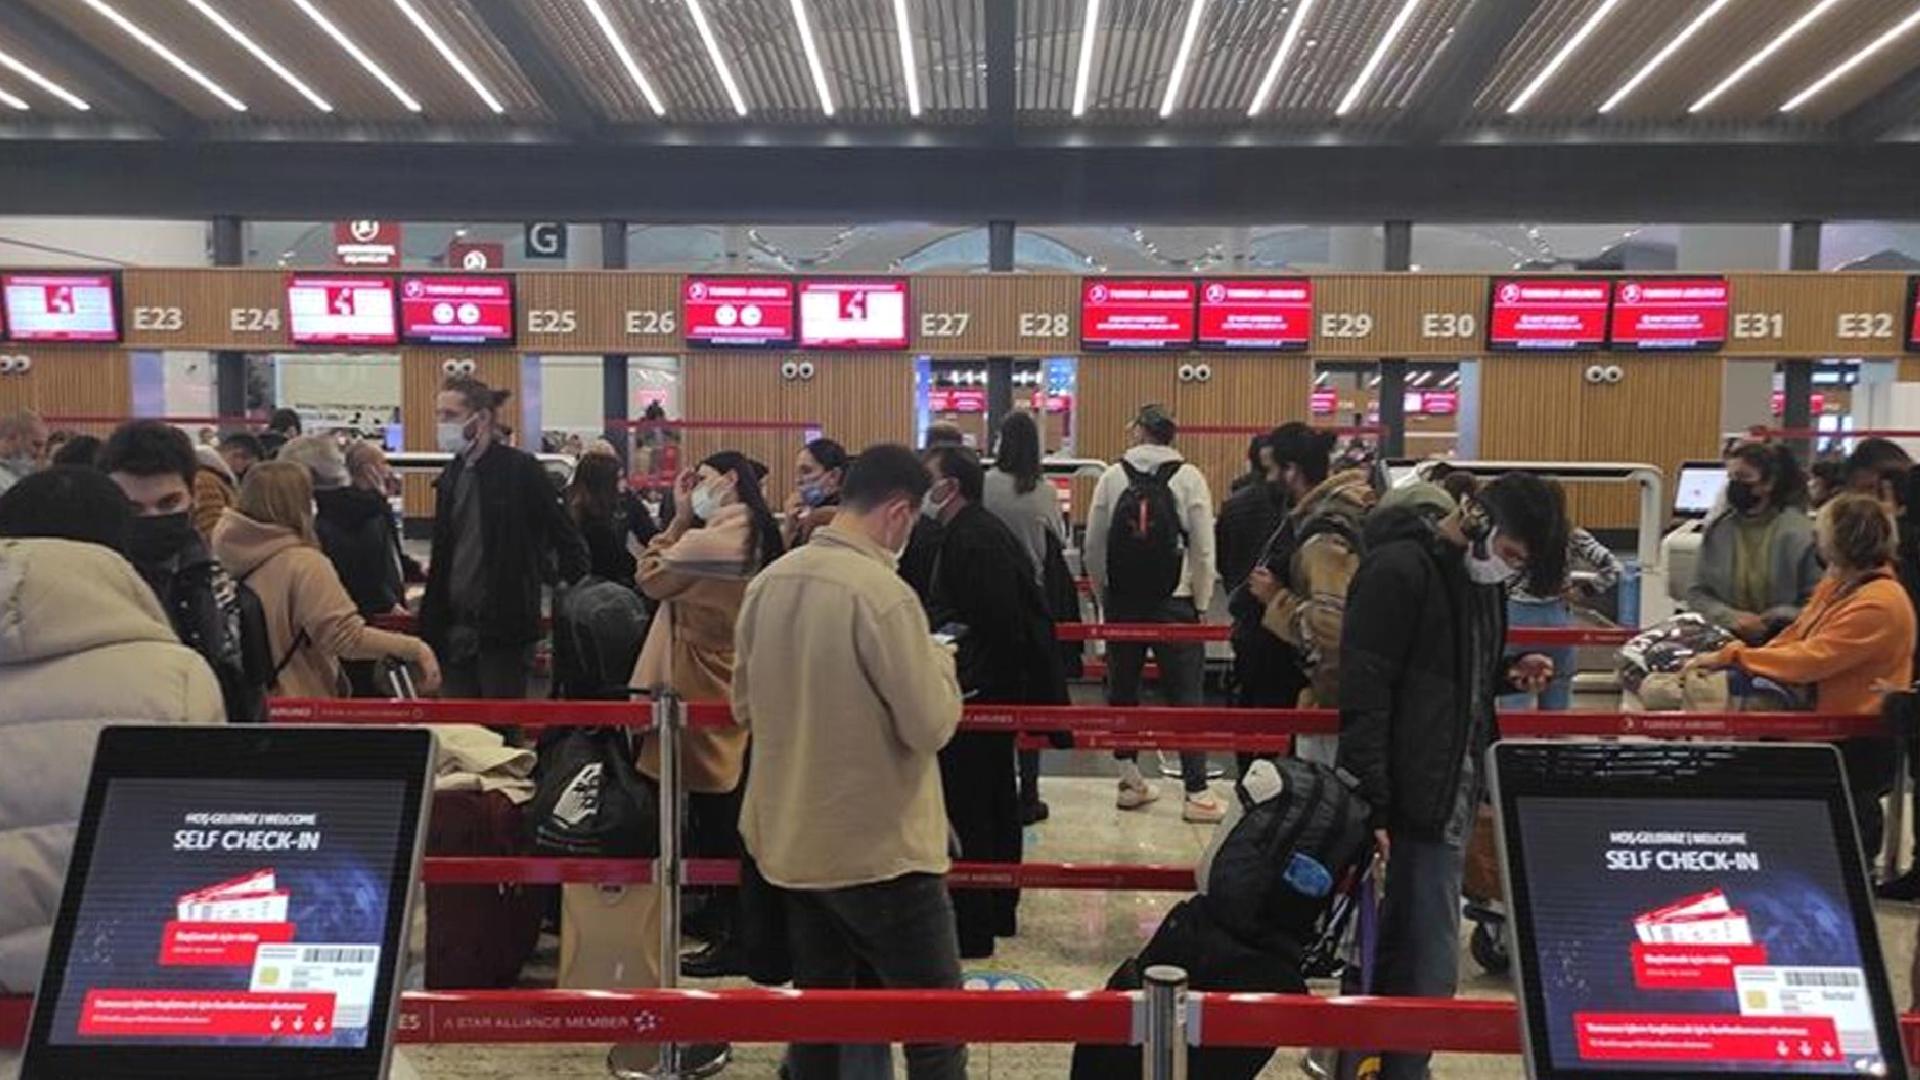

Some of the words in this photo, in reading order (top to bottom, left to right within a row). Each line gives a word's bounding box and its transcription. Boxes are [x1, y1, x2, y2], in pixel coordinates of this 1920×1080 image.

[530, 222, 557, 253] G
[134, 309, 183, 332] E23
[230, 309, 279, 332] E24
[528, 310, 576, 332] E25
[626, 311, 676, 333] E26
[921, 313, 969, 336] E27
[1019, 313, 1069, 336] E28
[1321, 314, 1372, 337] E29
[1422, 314, 1476, 338] E30
[1734, 314, 1783, 338] E31
[1838, 314, 1892, 338] E32
[173, 830, 220, 851] SELF
[221, 830, 320, 851] CHECK-IN
[1605, 850, 1652, 871] SELF
[1656, 850, 1759, 871] CHECK-IN
[456, 1018, 493, 1029] STAR
[495, 1018, 563, 1029] ALLIANCE
[565, 1018, 629, 1029] MEMBER
